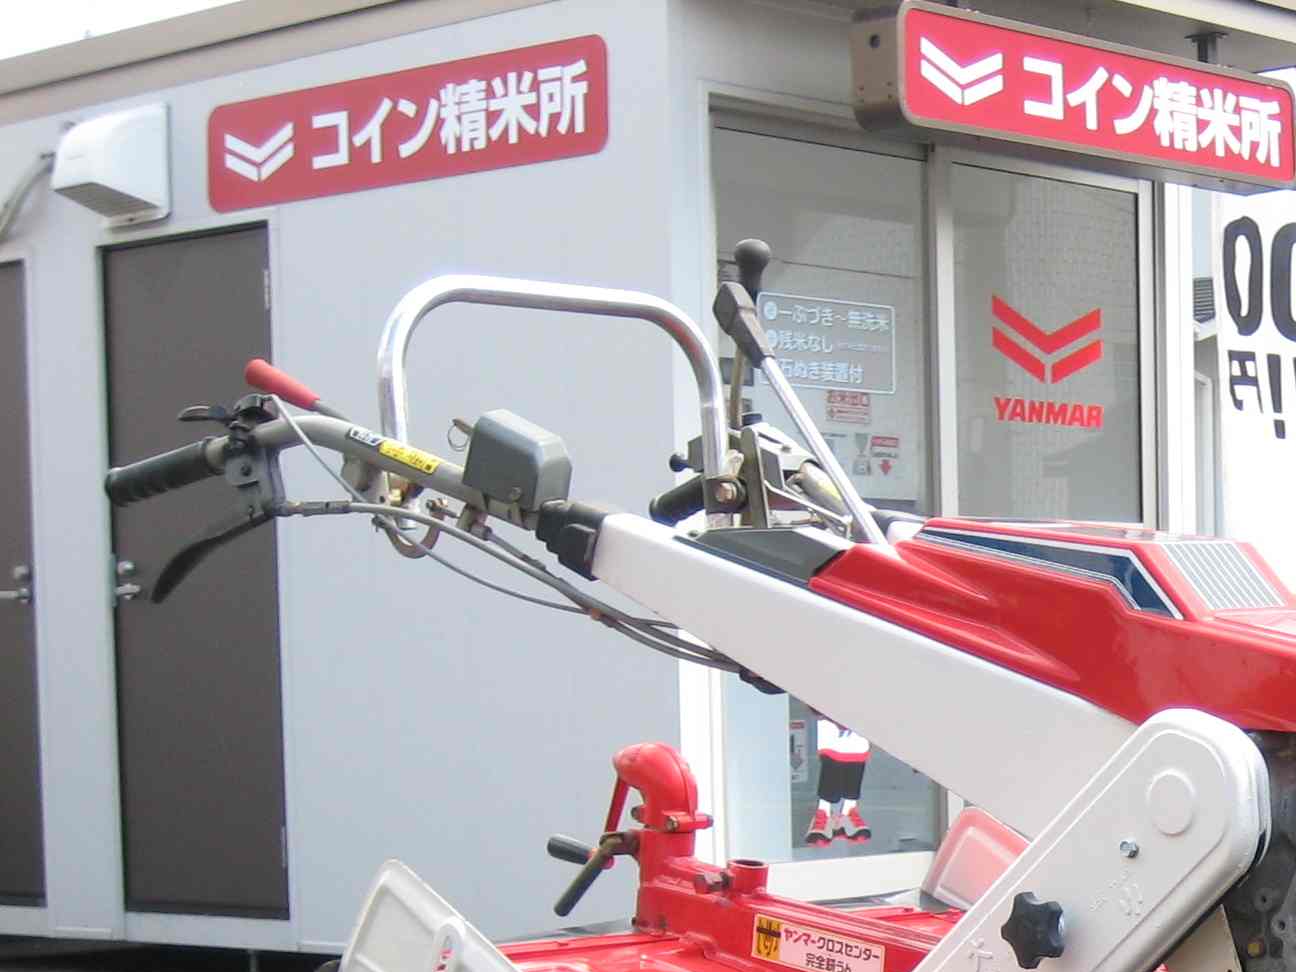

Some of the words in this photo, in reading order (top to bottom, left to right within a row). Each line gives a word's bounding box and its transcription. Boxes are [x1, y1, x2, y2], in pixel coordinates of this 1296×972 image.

[311, 59, 589, 170] コイン精米所
[1023, 56, 1282, 167] コイン精米所
[992, 396, 1104, 430] YANMAR
[783, 927, 881, 961] ヤンマークロスセンター
